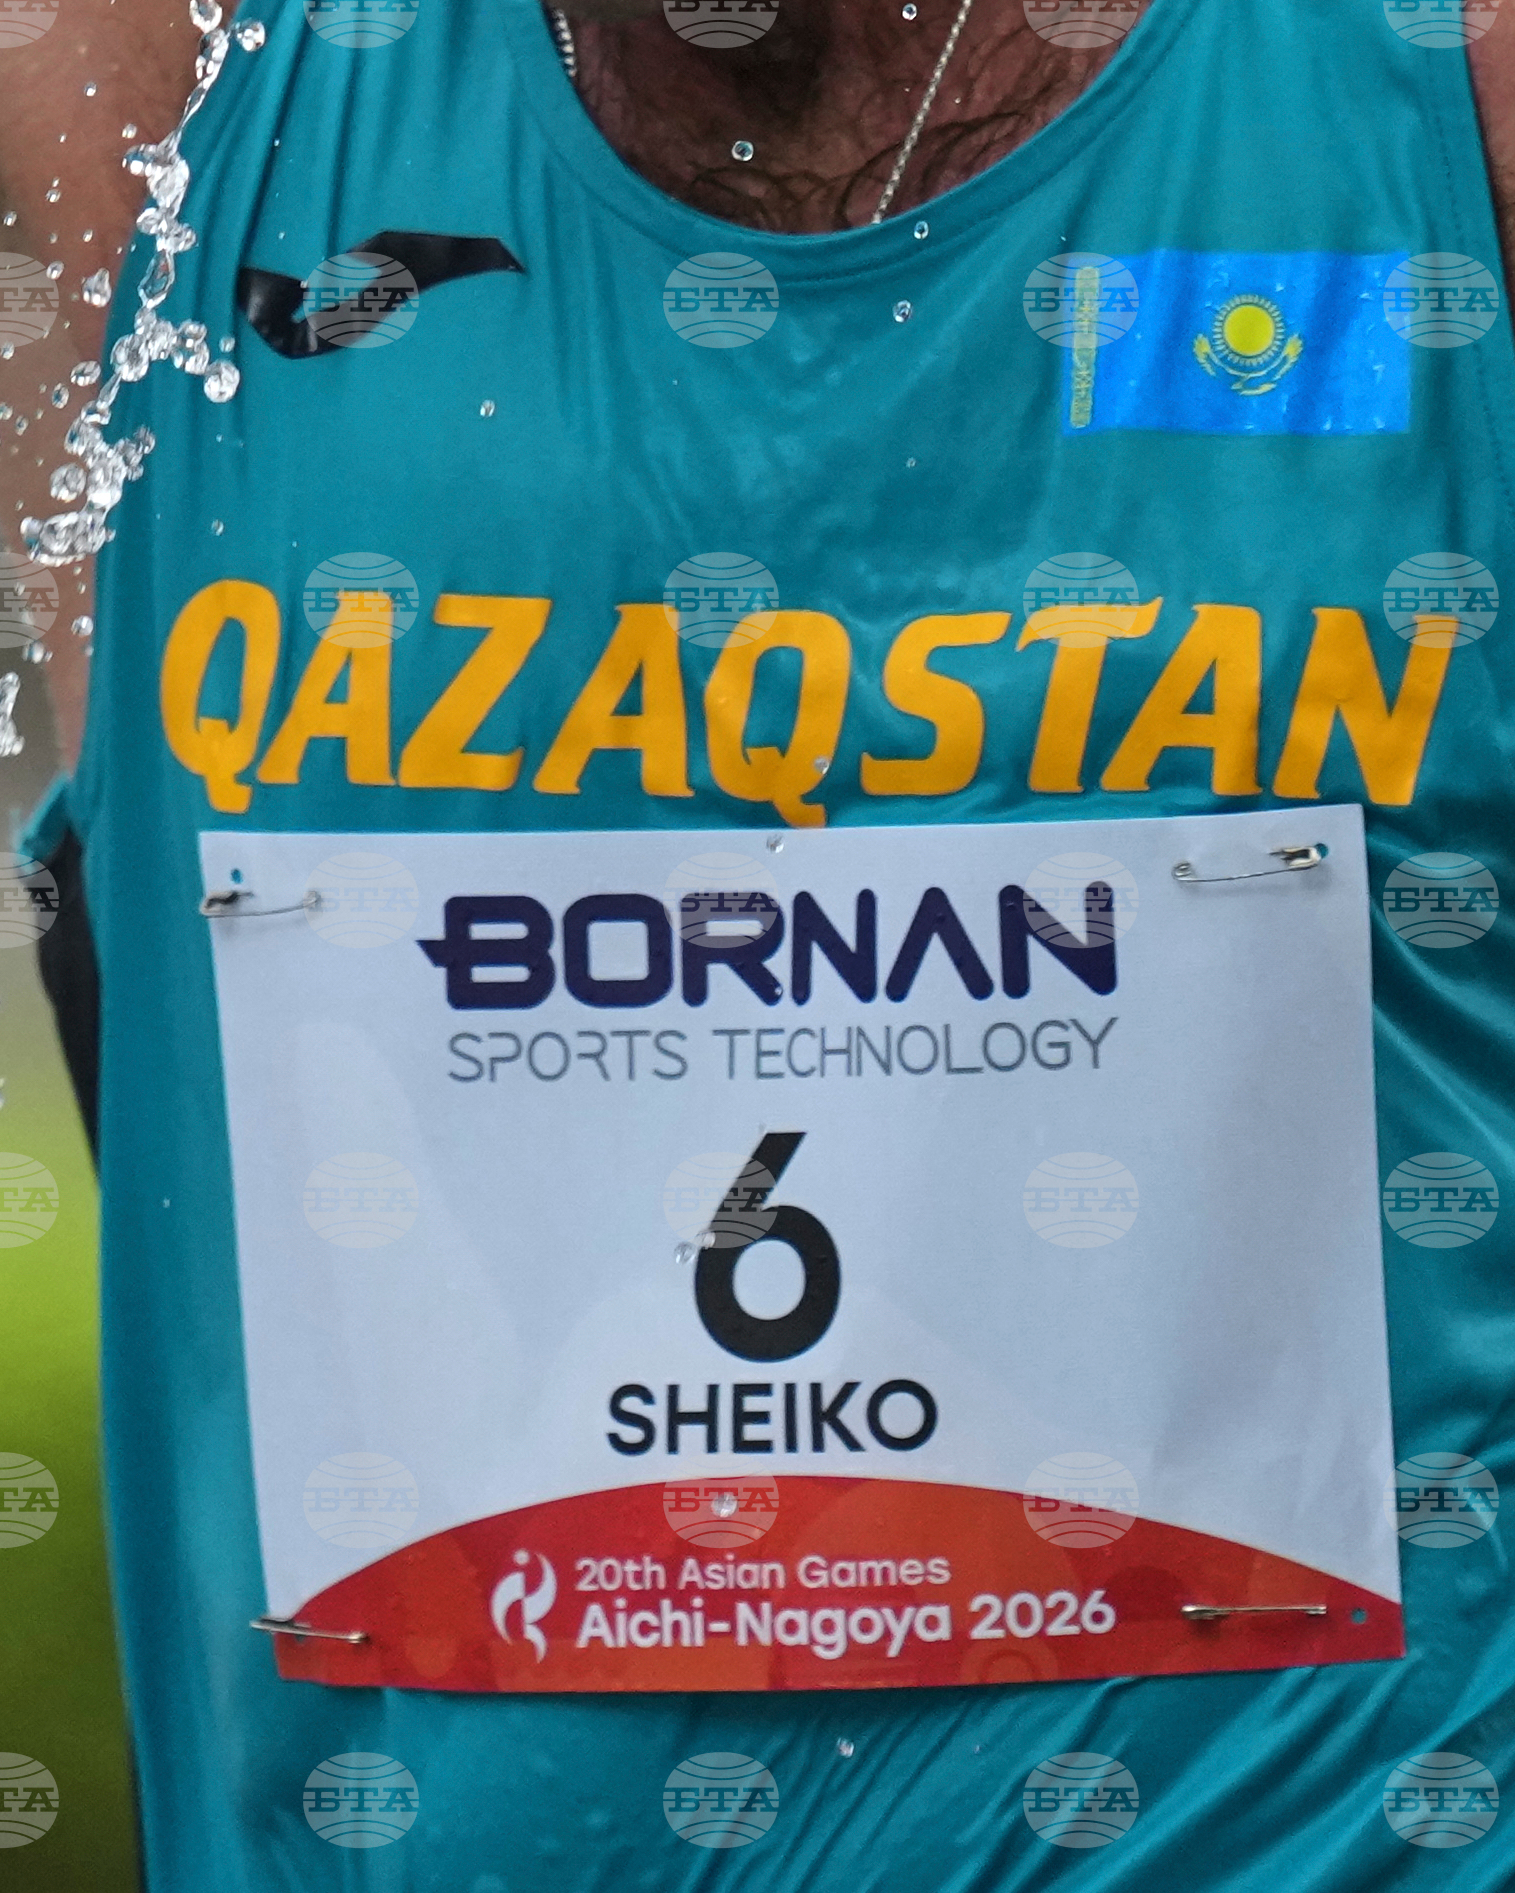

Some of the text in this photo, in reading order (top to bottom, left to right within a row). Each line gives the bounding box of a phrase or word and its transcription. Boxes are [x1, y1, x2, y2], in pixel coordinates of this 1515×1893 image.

[160, 579, 1458, 827] QAZAQSTAN
[417, 881, 1118, 1009] BORNAN
[447, 1016, 1120, 1083] SPORTS TECHNOLOGY
[694, 1131, 842, 1363] 6
[607, 1379, 938, 1456] SHEIKO
[576, 1555, 952, 1591] 20th Asian Games
[576, 1590, 1116, 1660] Aichi-Nagoya 2026
